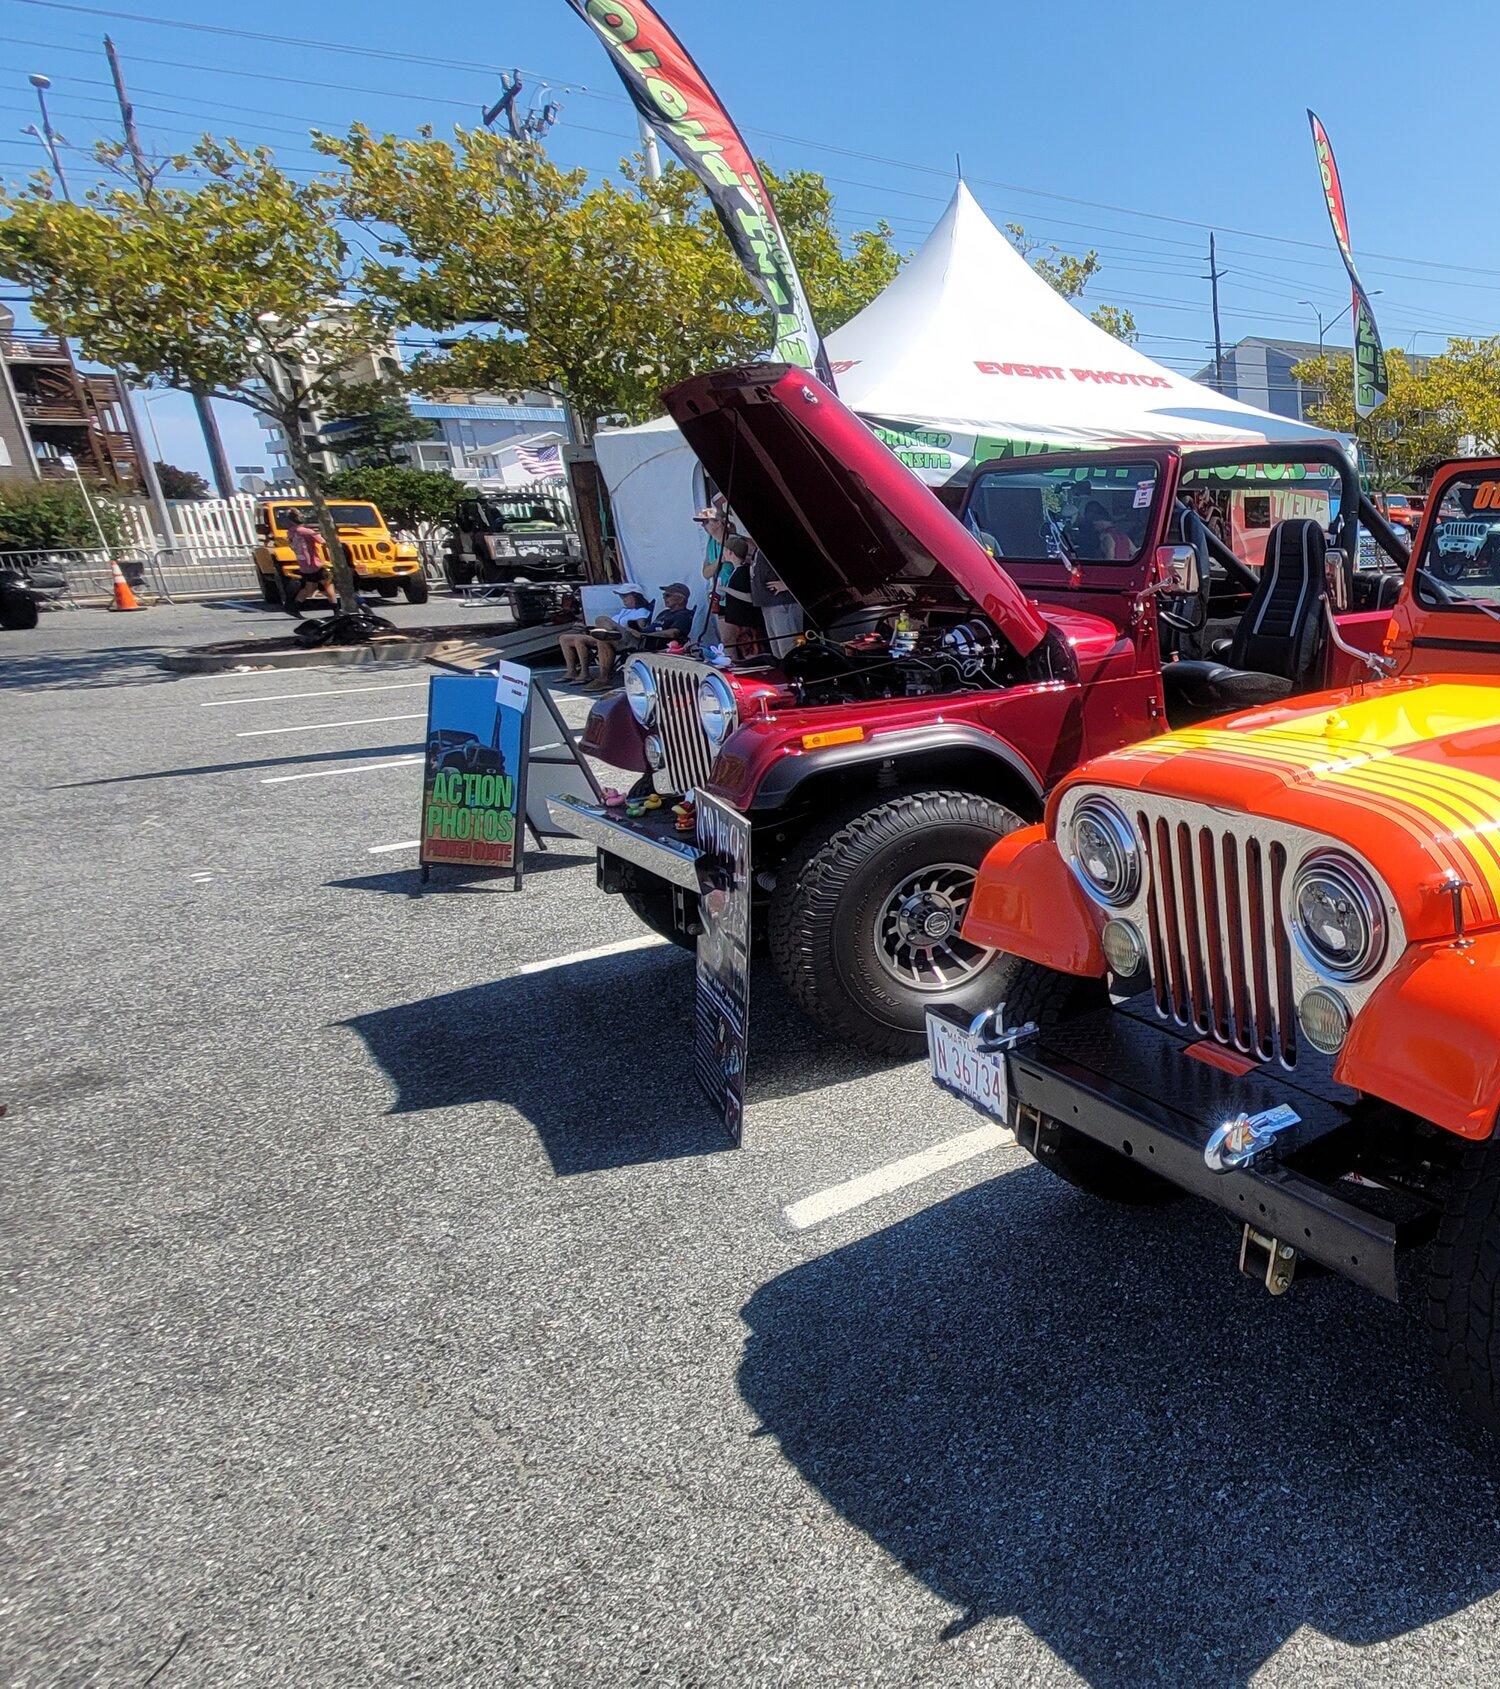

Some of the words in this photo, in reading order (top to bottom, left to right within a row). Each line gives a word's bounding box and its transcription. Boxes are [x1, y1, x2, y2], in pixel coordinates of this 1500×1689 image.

[973, 360, 1067, 382] EVENT
[1069, 366, 1174, 389] PHOTOS
[873, 428, 952, 449] PRINTED
[895, 451, 951, 469] NSITE
[432, 772, 513, 808] ACTION
[427, 804, 514, 842] PHOTOS
[951, 1046, 1001, 1106] 36734
